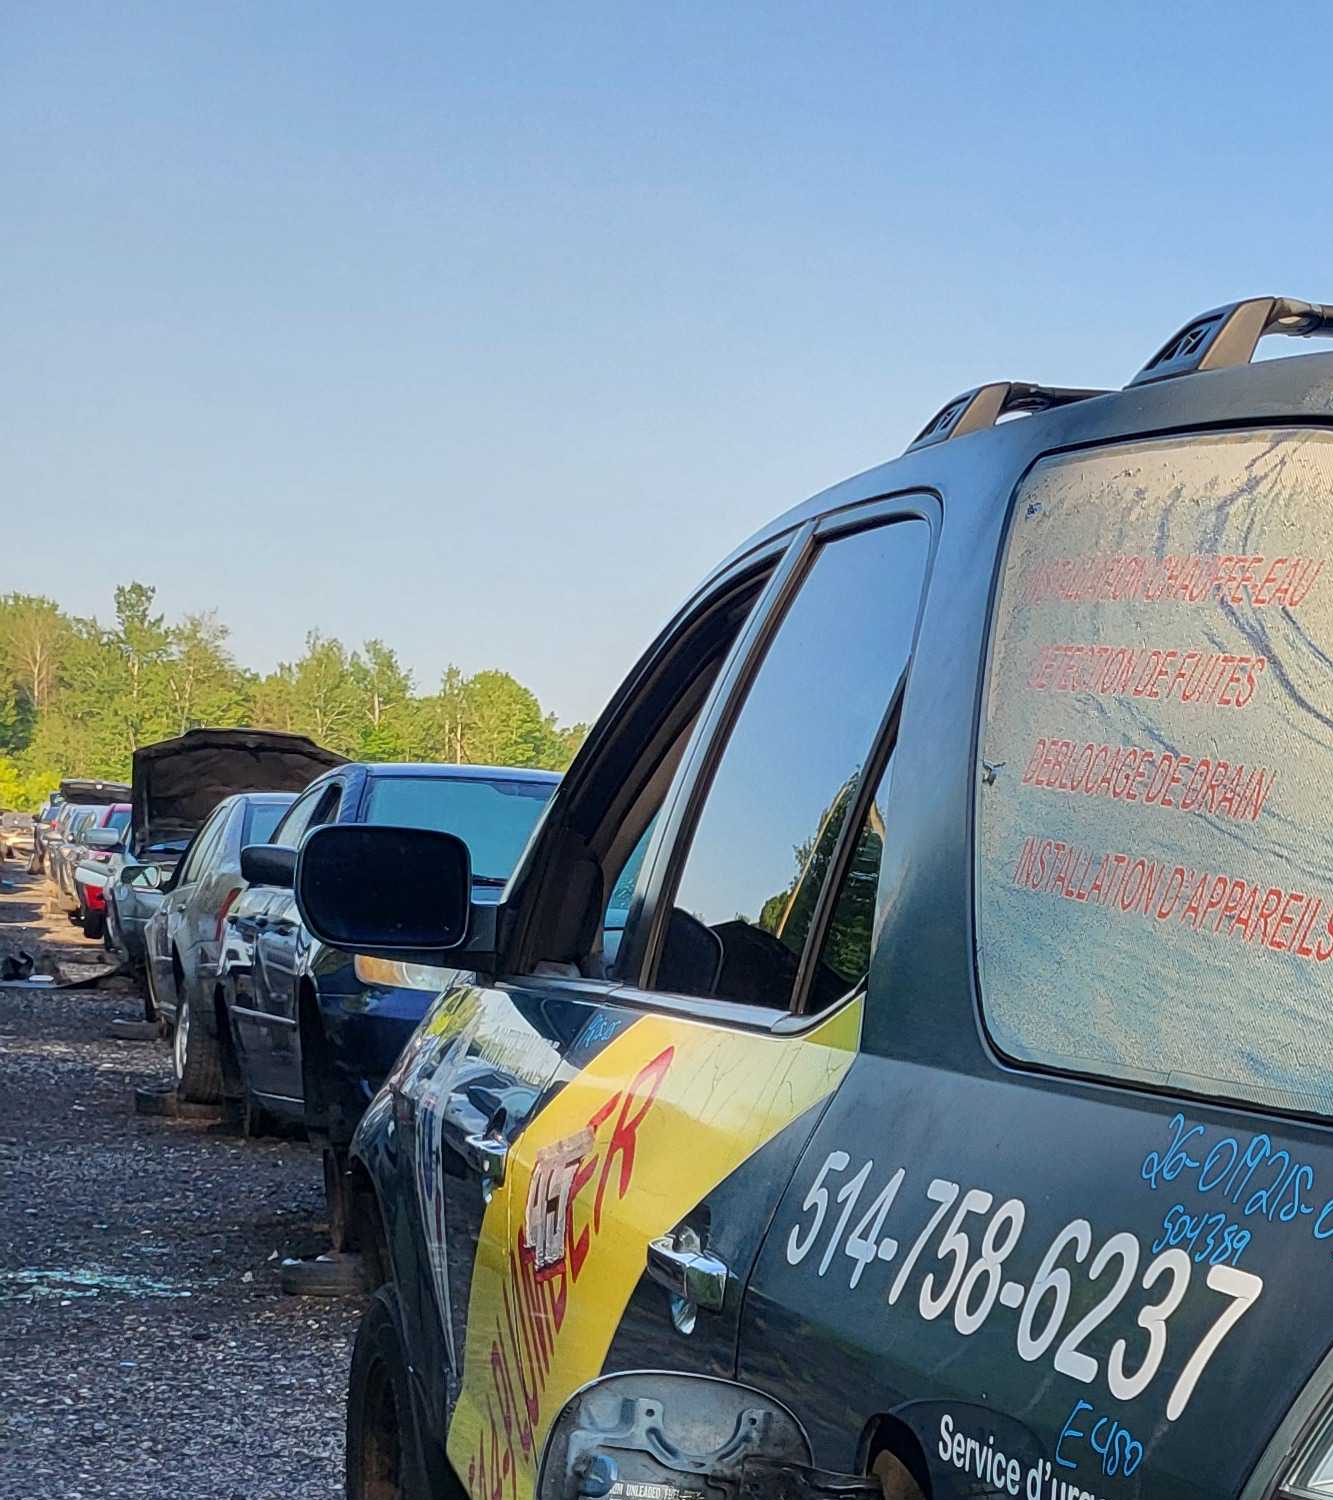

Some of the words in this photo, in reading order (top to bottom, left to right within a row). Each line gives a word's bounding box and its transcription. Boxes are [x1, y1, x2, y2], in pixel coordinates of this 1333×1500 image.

[1132, 649, 1179, 699] DE
[1167, 652, 1266, 710] FUITES
[1145, 752, 1192, 808] DE
[1180, 757, 1279, 822] DRAIN
[1013, 835, 1165, 914] INSTALLATION
[785, 1149, 1263, 1422] 514-758-6237
[936, 1412, 1023, 1491] Service
